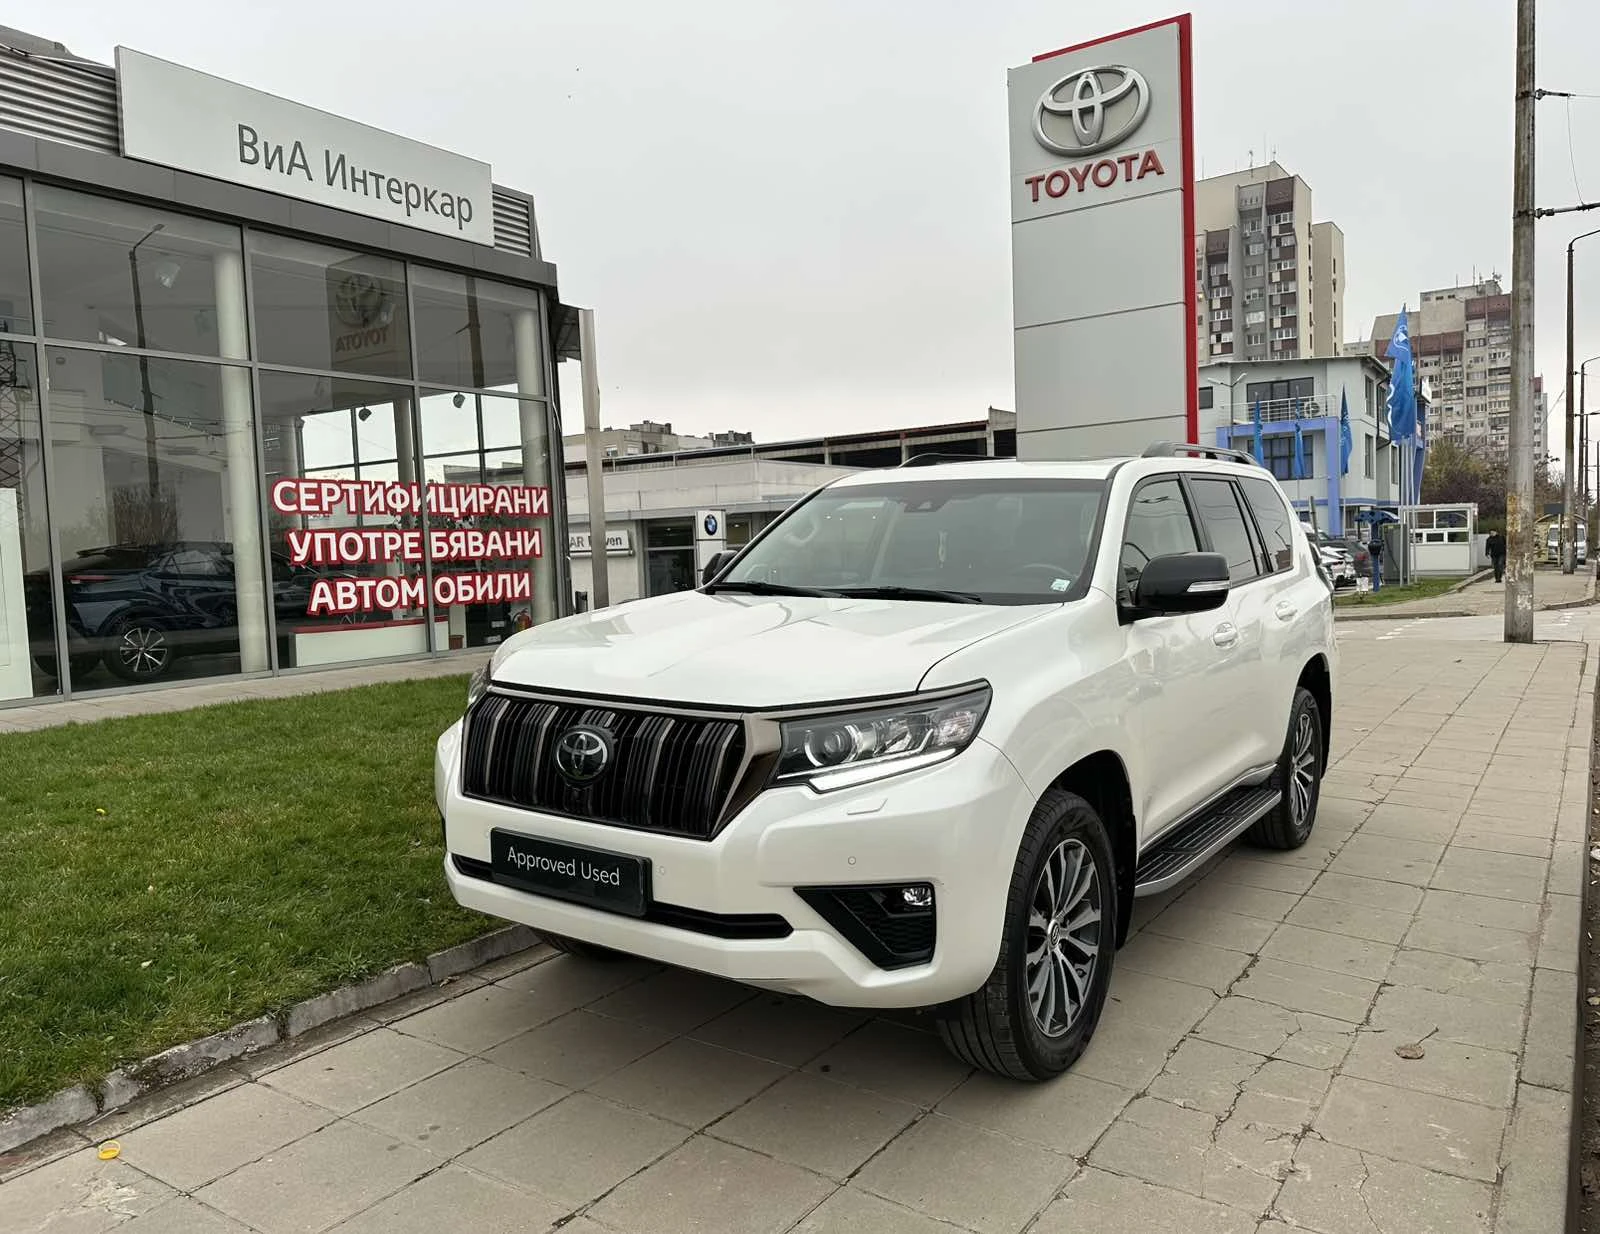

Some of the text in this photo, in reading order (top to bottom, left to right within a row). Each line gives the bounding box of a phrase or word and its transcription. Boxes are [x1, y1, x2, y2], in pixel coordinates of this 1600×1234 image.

[238, 123, 473, 230] ВиА Интеркар
[1024, 149, 1165, 203] TOYOTA
[273, 480, 549, 518] СЕРТИФИЦИРАНИ
[507, 846, 620, 886] Approved Used
